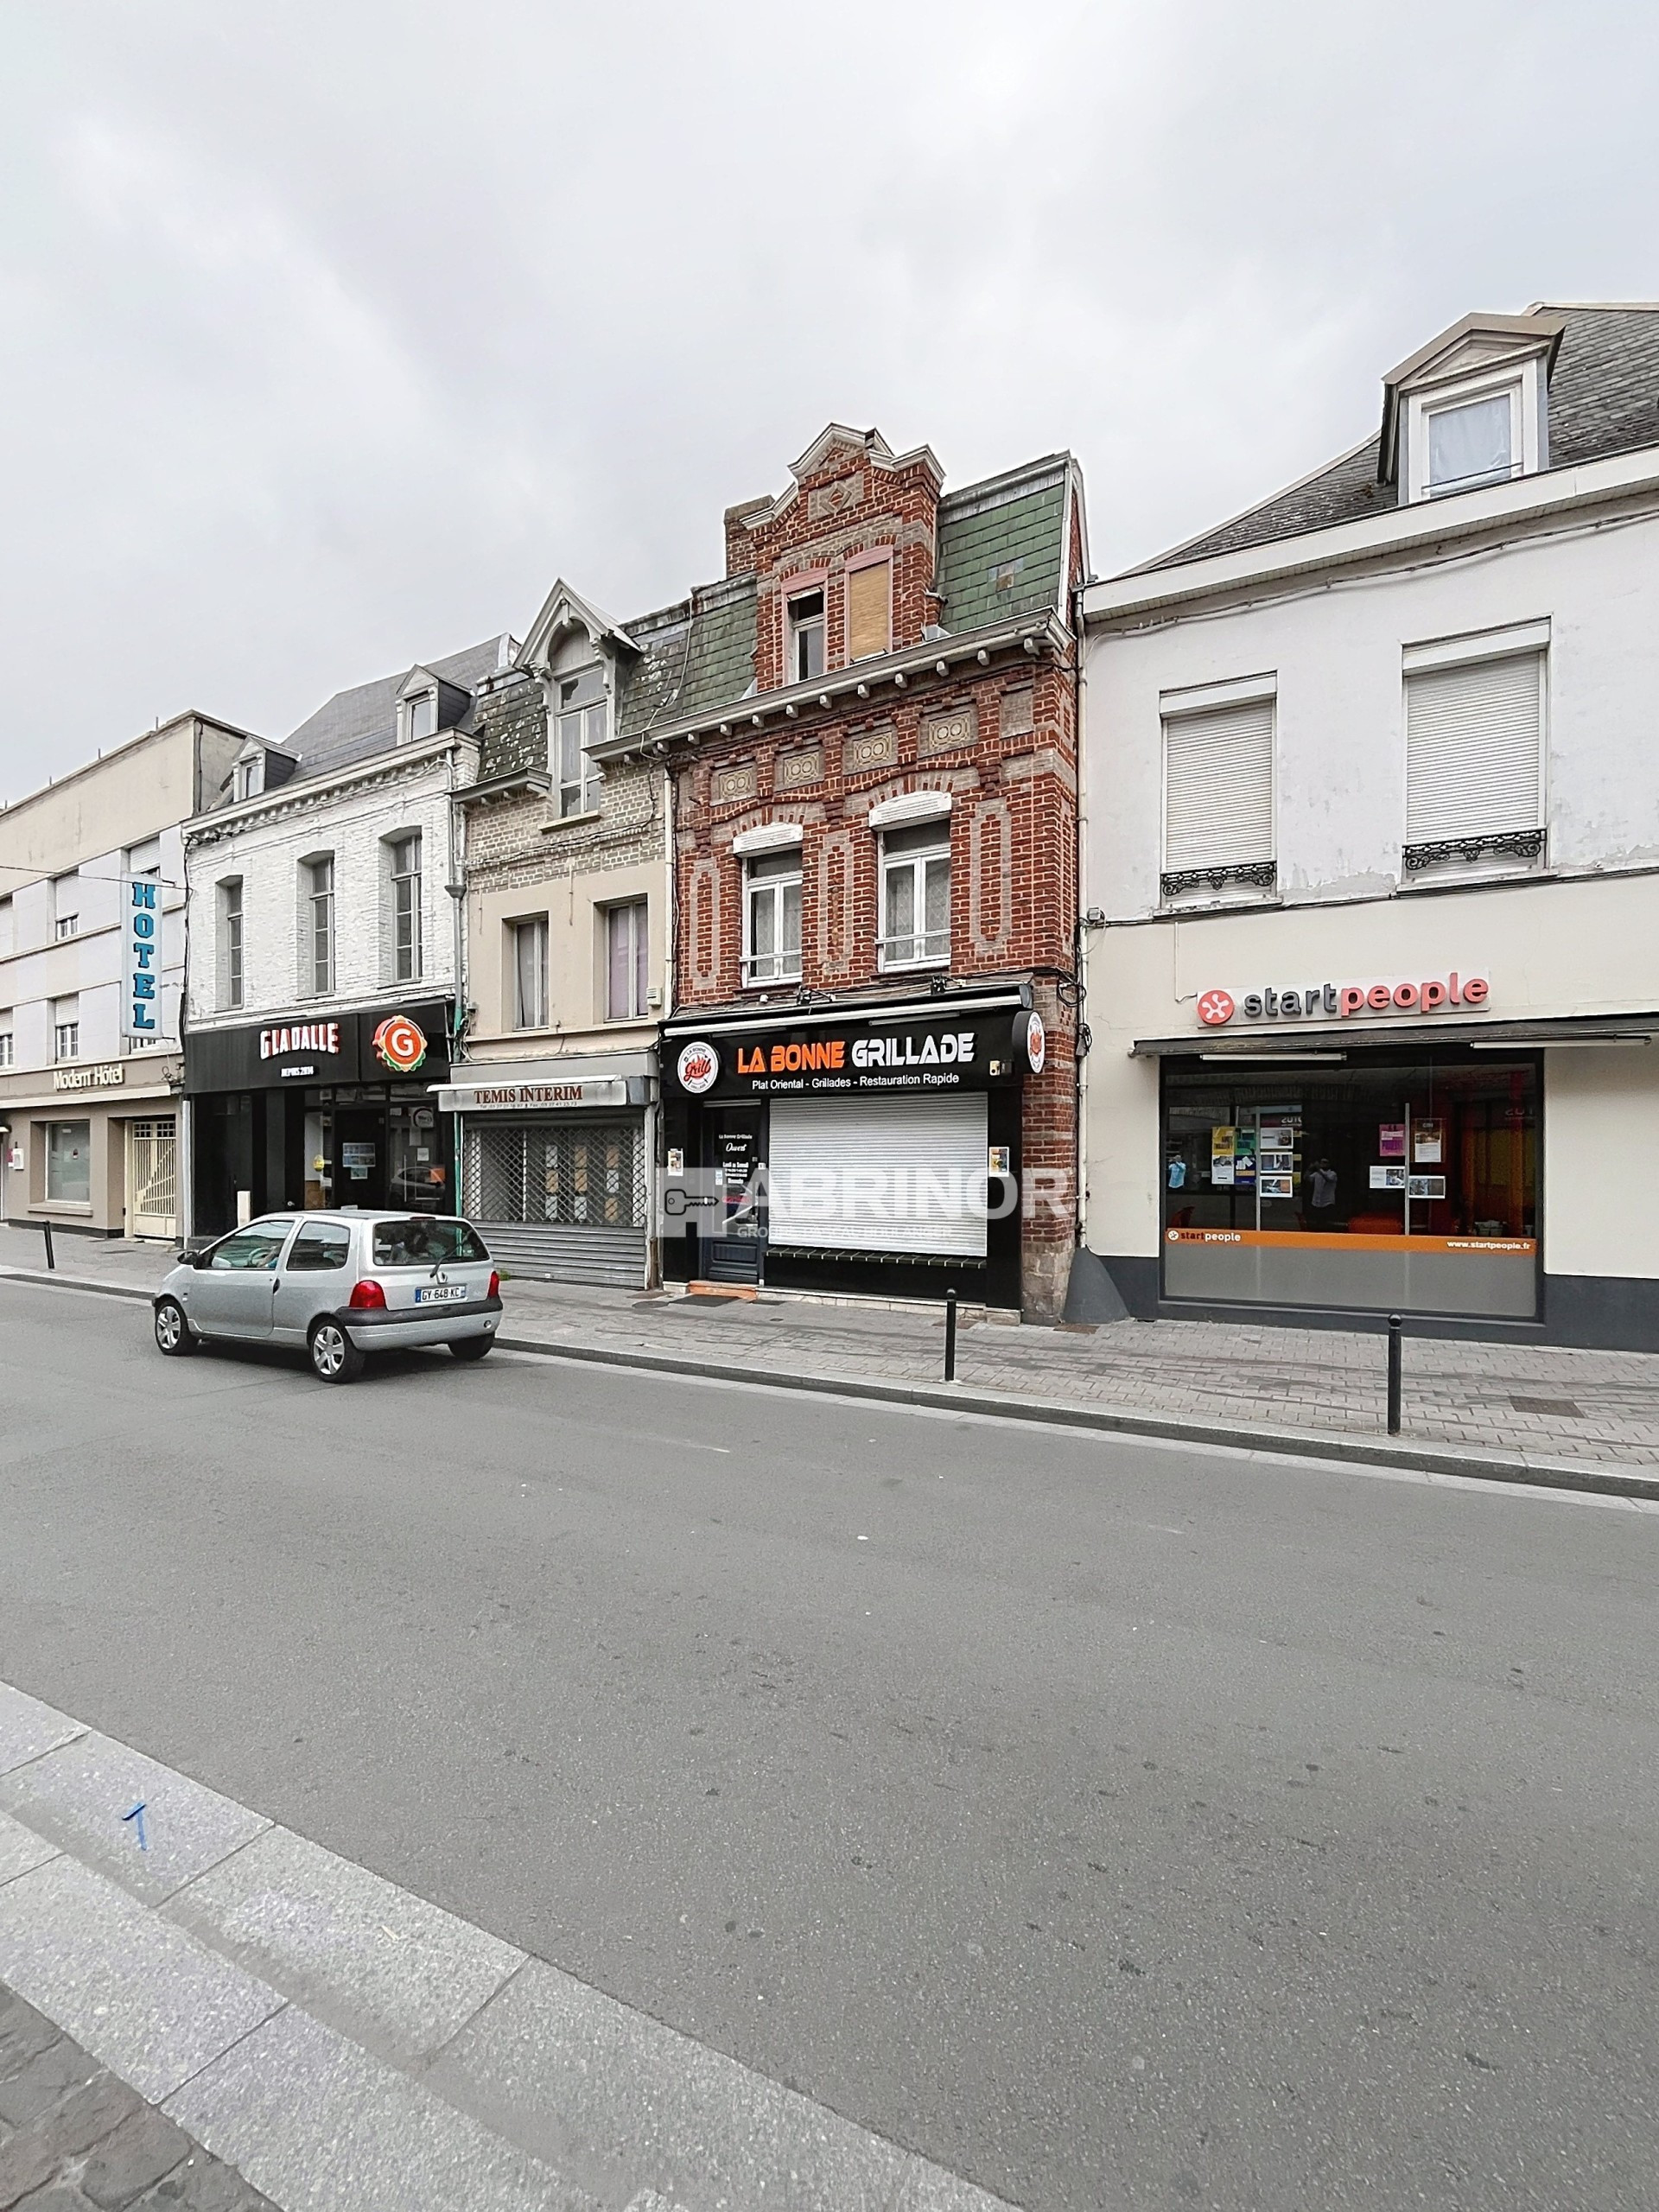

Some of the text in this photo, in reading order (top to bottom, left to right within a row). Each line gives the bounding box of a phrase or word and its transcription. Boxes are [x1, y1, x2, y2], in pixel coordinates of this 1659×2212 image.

[132, 881, 156, 1030] HOTEL
[1244, 972, 1489, 1018] startpeople
[738, 1033, 976, 1074] LA BONNE GRILLADE
[53, 1064, 124, 1090] Modern Hôtel
[752, 1079, 769, 1090] Plat
[770, 1078, 804, 1090] Oriental
[811, 1077, 851, 1089] Grillades
[860, 1074, 921, 1087] Restauration
[923, 1072, 959, 1086] Rapide
[474, 1085, 583, 1104] TEMIS INTERIM
[1181, 1231, 1242, 1243] startpeople
[1446, 1241, 1531, 1250] www.startpeople.fr
